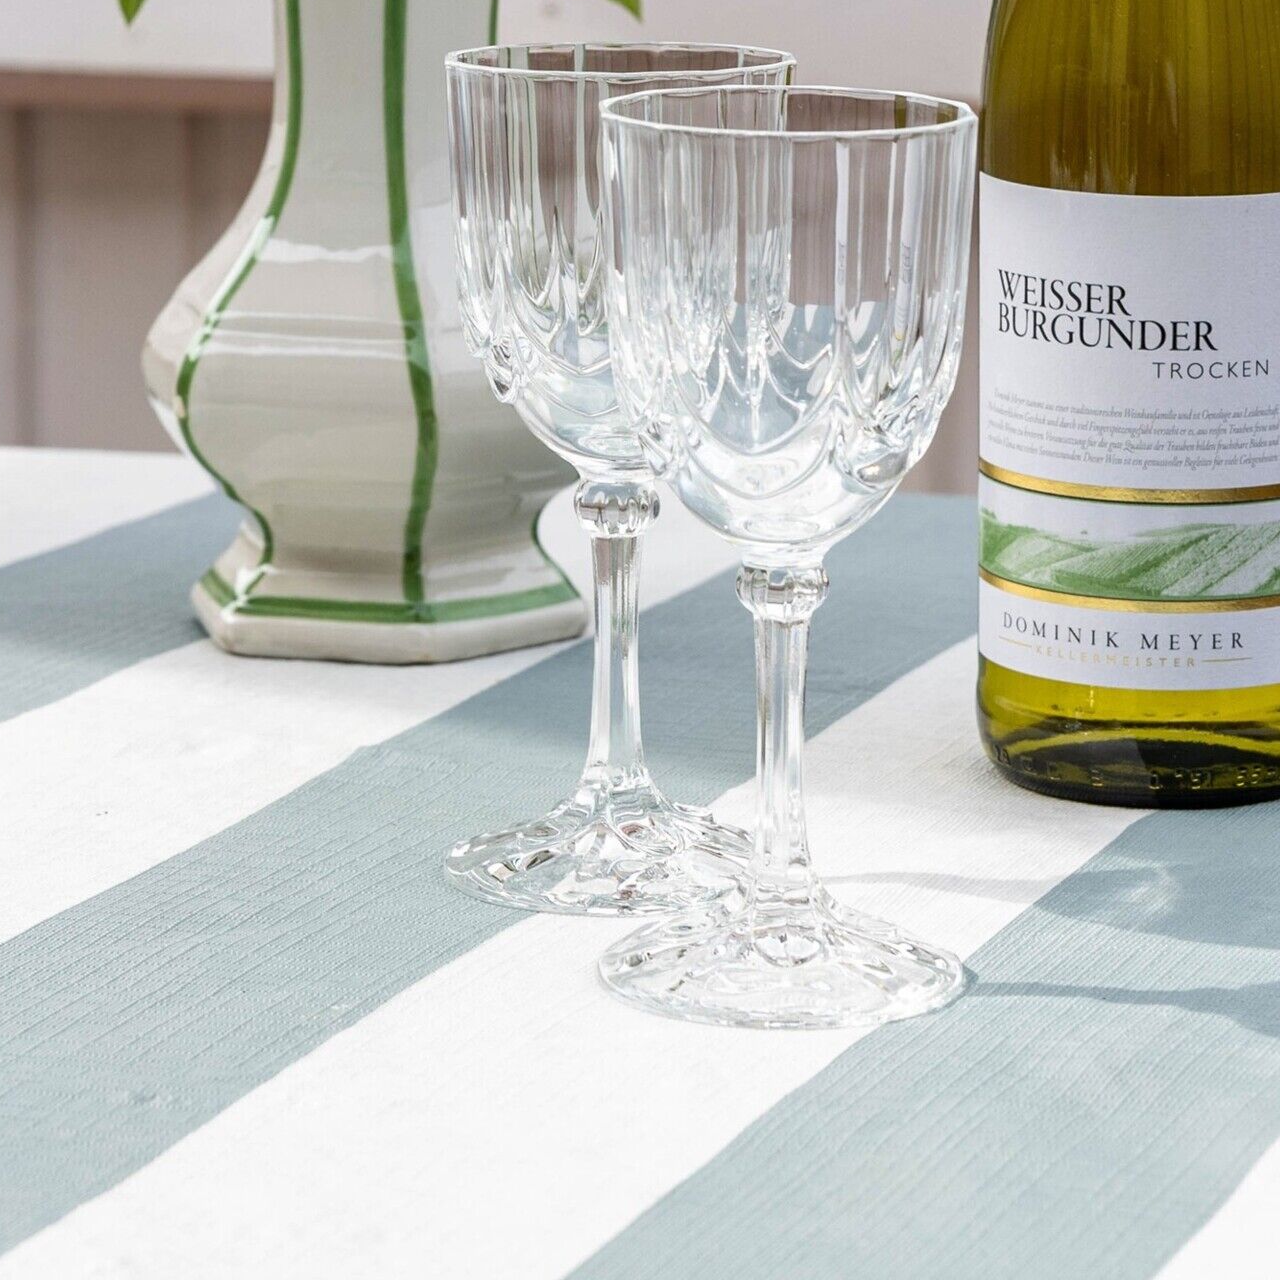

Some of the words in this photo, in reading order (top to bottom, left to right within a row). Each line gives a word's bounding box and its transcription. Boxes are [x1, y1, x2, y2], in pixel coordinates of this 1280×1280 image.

[998, 268, 1132, 316] WEISSER
[998, 302, 1218, 351] BURGUNDER
[1152, 359, 1269, 380] TROCKEN
[1003, 611, 1119, 648] DOMINIK
[1141, 631, 1244, 650] MEYER
[1034, 645, 1196, 668] KELLERMEISTER
